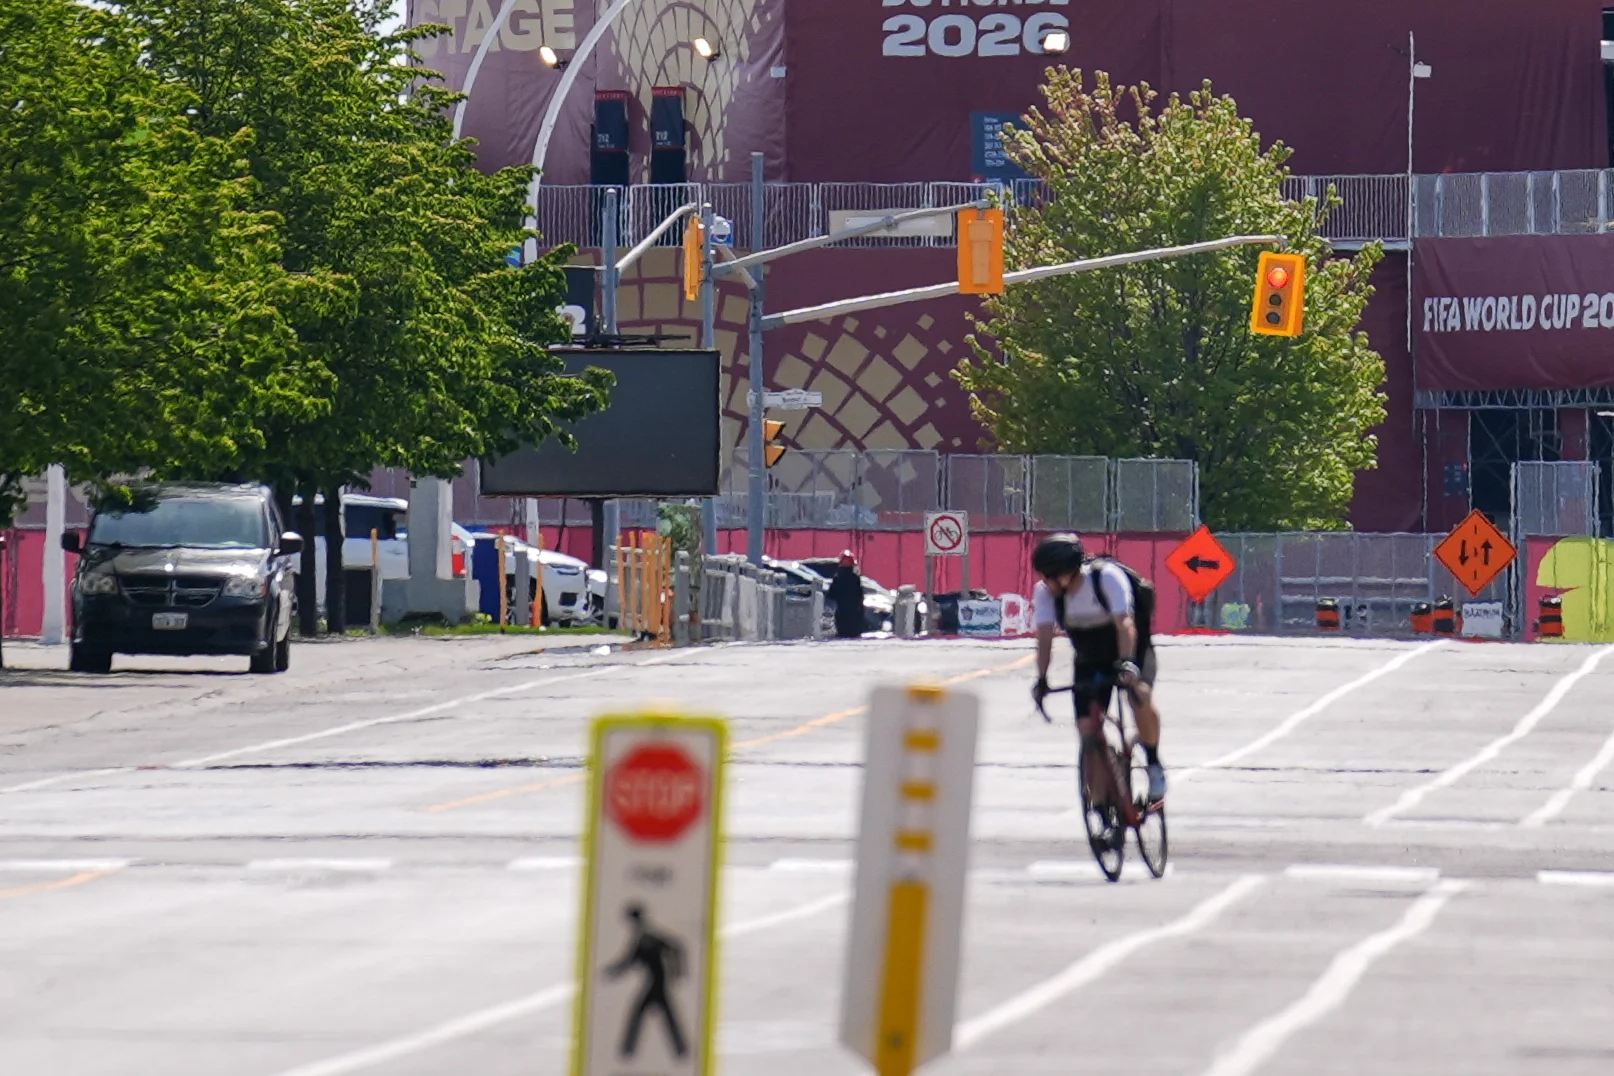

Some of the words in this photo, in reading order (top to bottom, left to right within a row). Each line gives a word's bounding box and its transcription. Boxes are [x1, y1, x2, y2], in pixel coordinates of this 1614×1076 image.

[882, 12, 1070, 56] 2026
[1423, 296, 1461, 332] FIFA
[1463, 294, 1537, 331] WORLD
[1539, 293, 1580, 330] CUP
